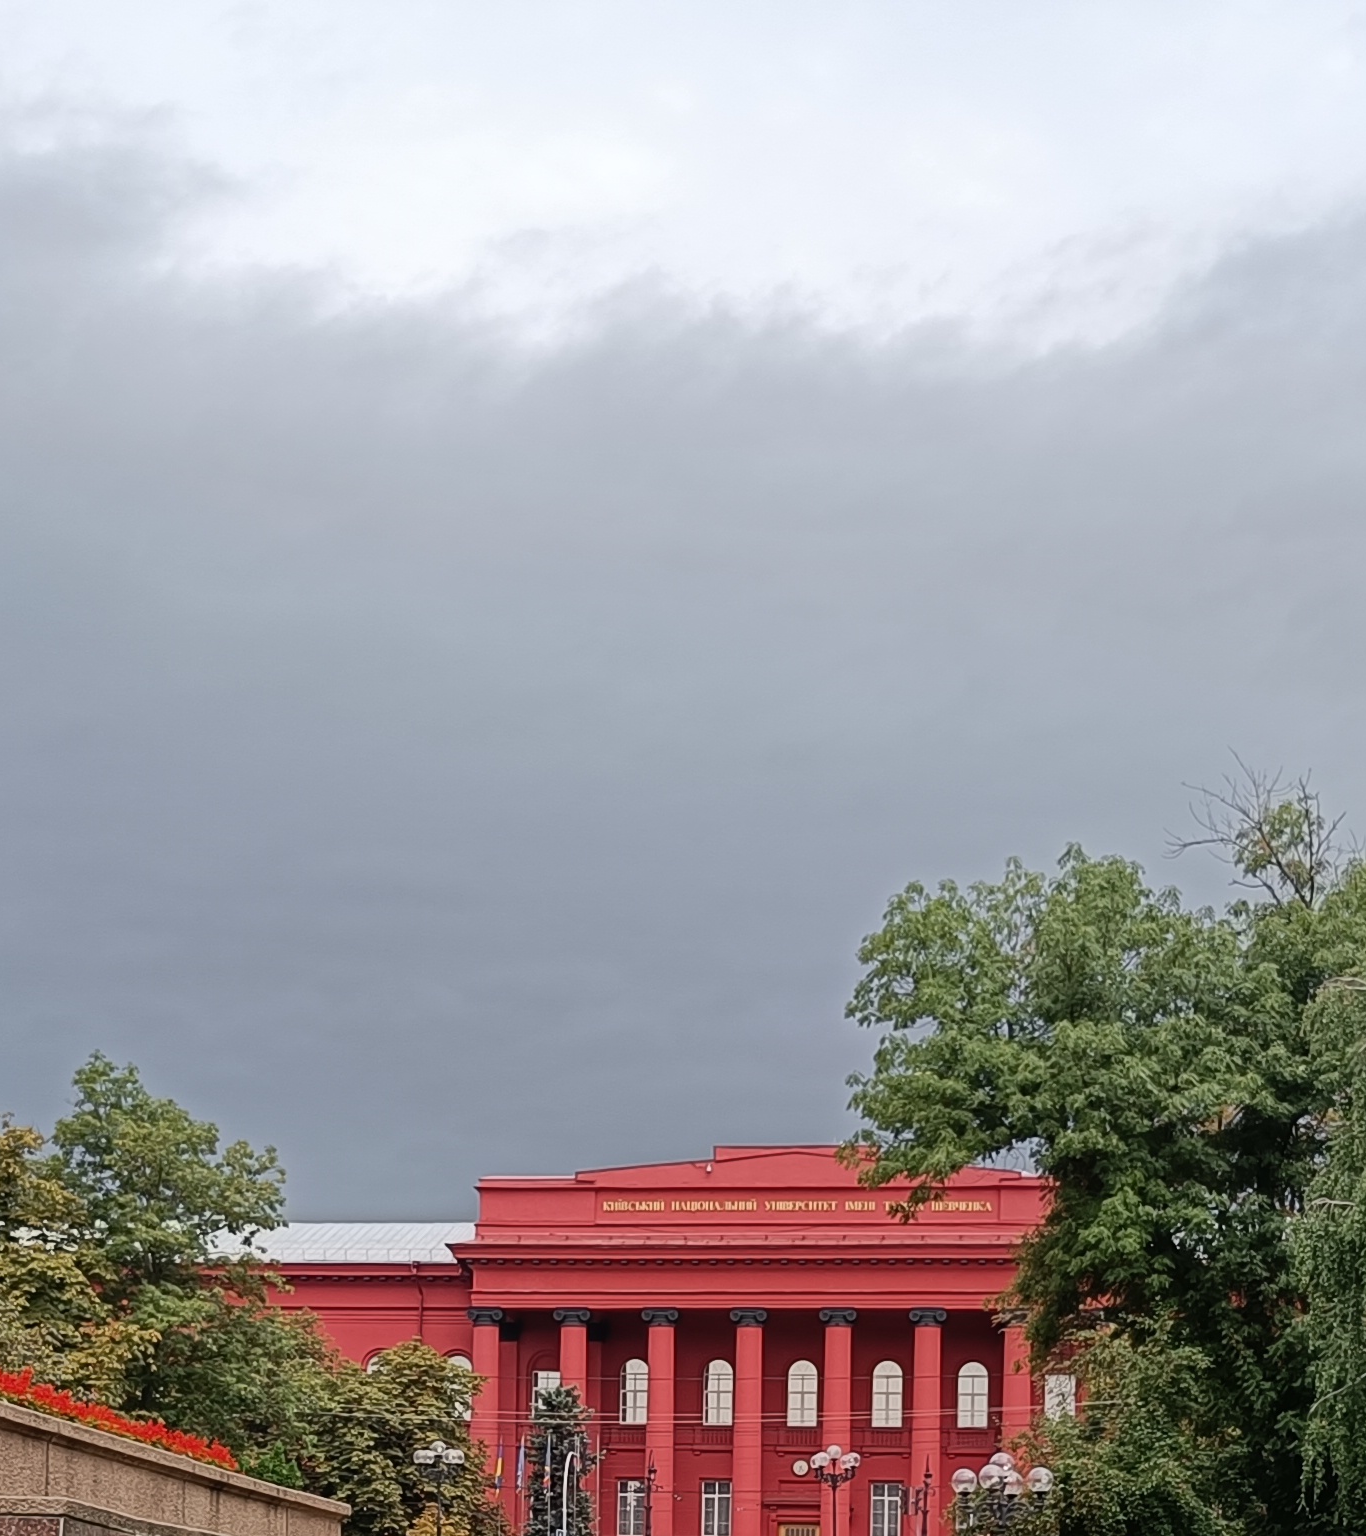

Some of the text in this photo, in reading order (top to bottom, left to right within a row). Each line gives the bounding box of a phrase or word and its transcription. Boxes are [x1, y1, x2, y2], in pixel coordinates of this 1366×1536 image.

[764, 1200, 838, 1211] УНІВЕРСИТЕТ
[845, 1200, 876, 1211] ІМЕНІ
[931, 1200, 993, 1212] ШЕВЧЕНКА
